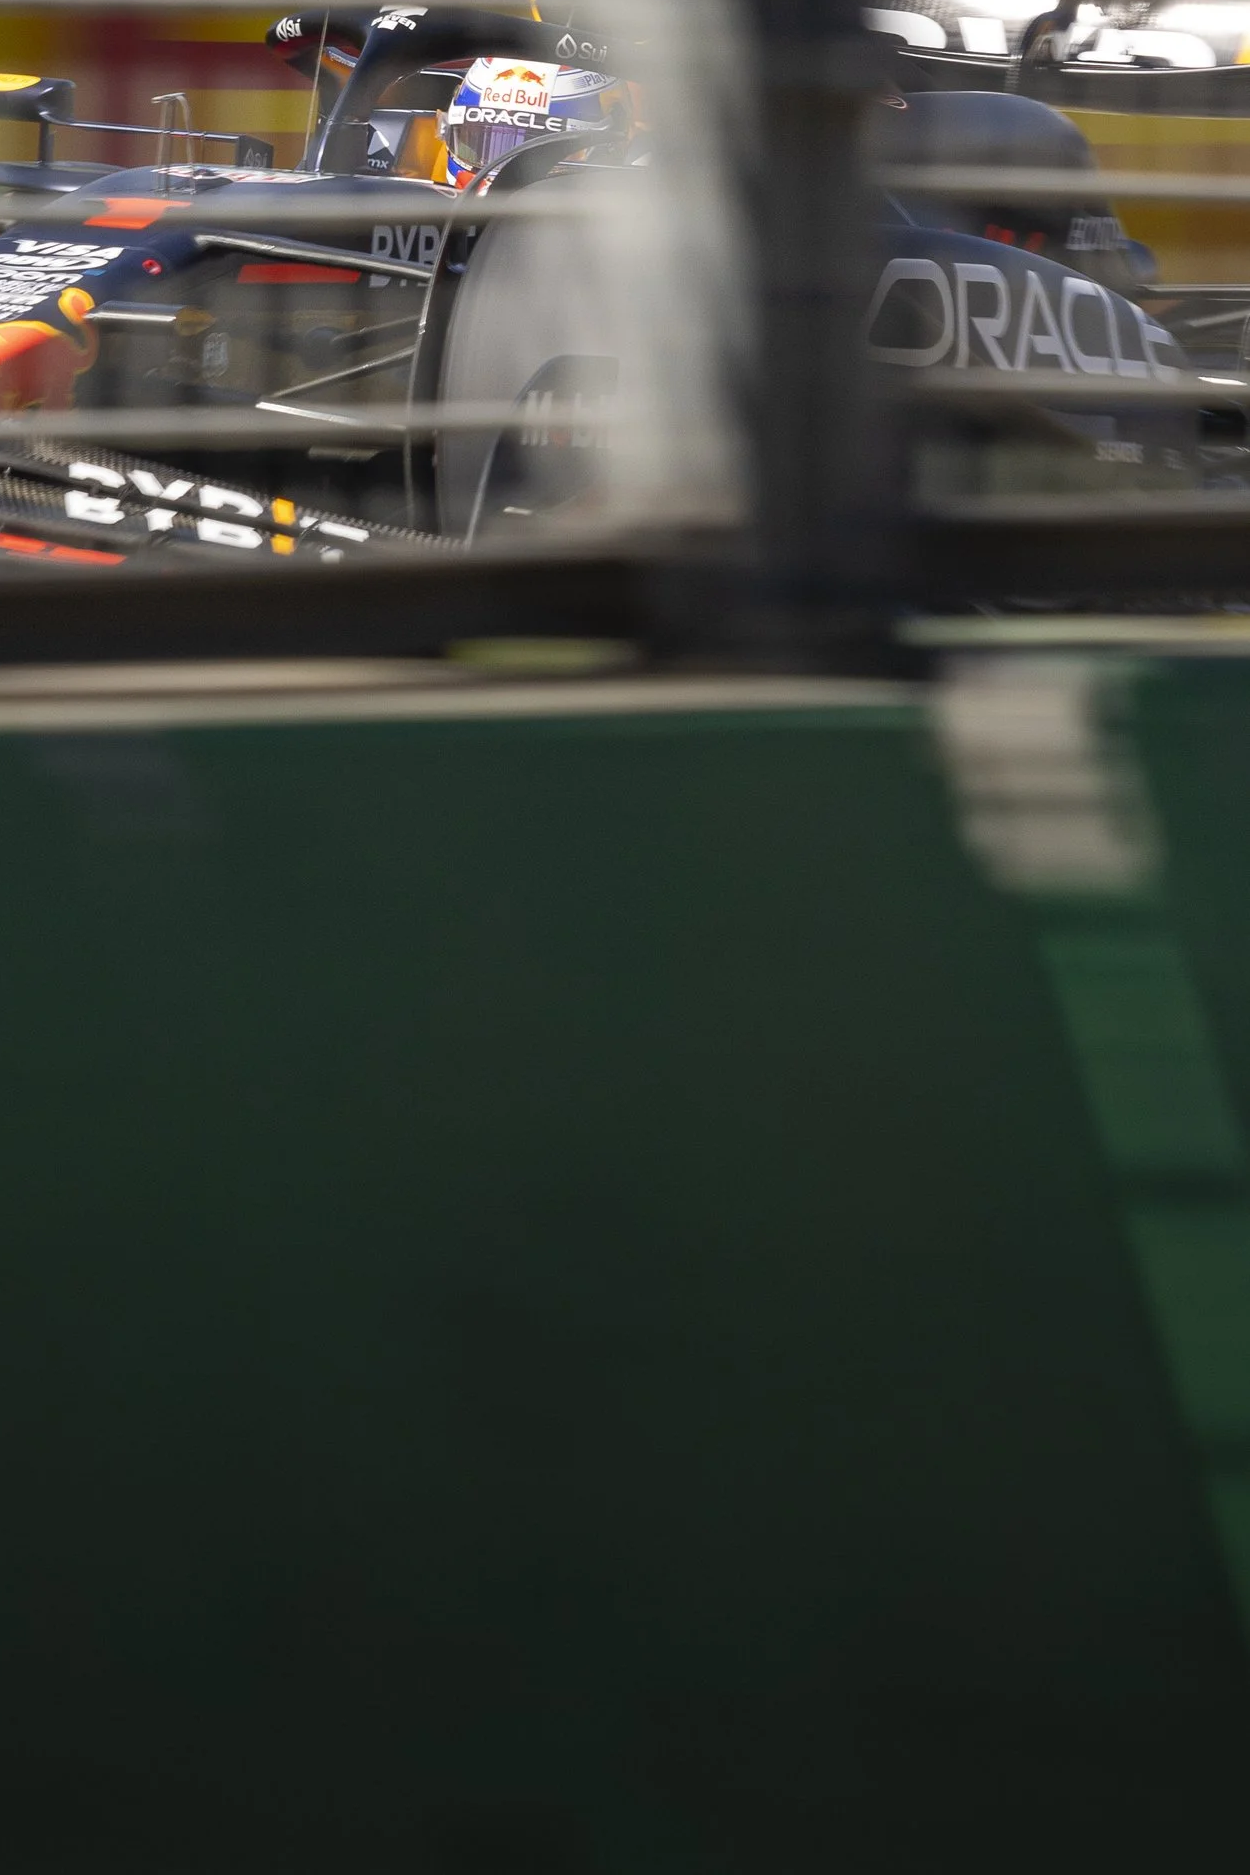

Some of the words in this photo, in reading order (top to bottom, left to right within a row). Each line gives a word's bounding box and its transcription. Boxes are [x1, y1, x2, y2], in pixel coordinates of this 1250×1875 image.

[578, 42, 607, 63] Sui
[483, 86, 511, 103] Red
[515, 89, 549, 108] Bull
[465, 107, 563, 132] ORACLE
[12, 239, 126, 260] VISA
[863, 258, 1183, 384] ORACLE
